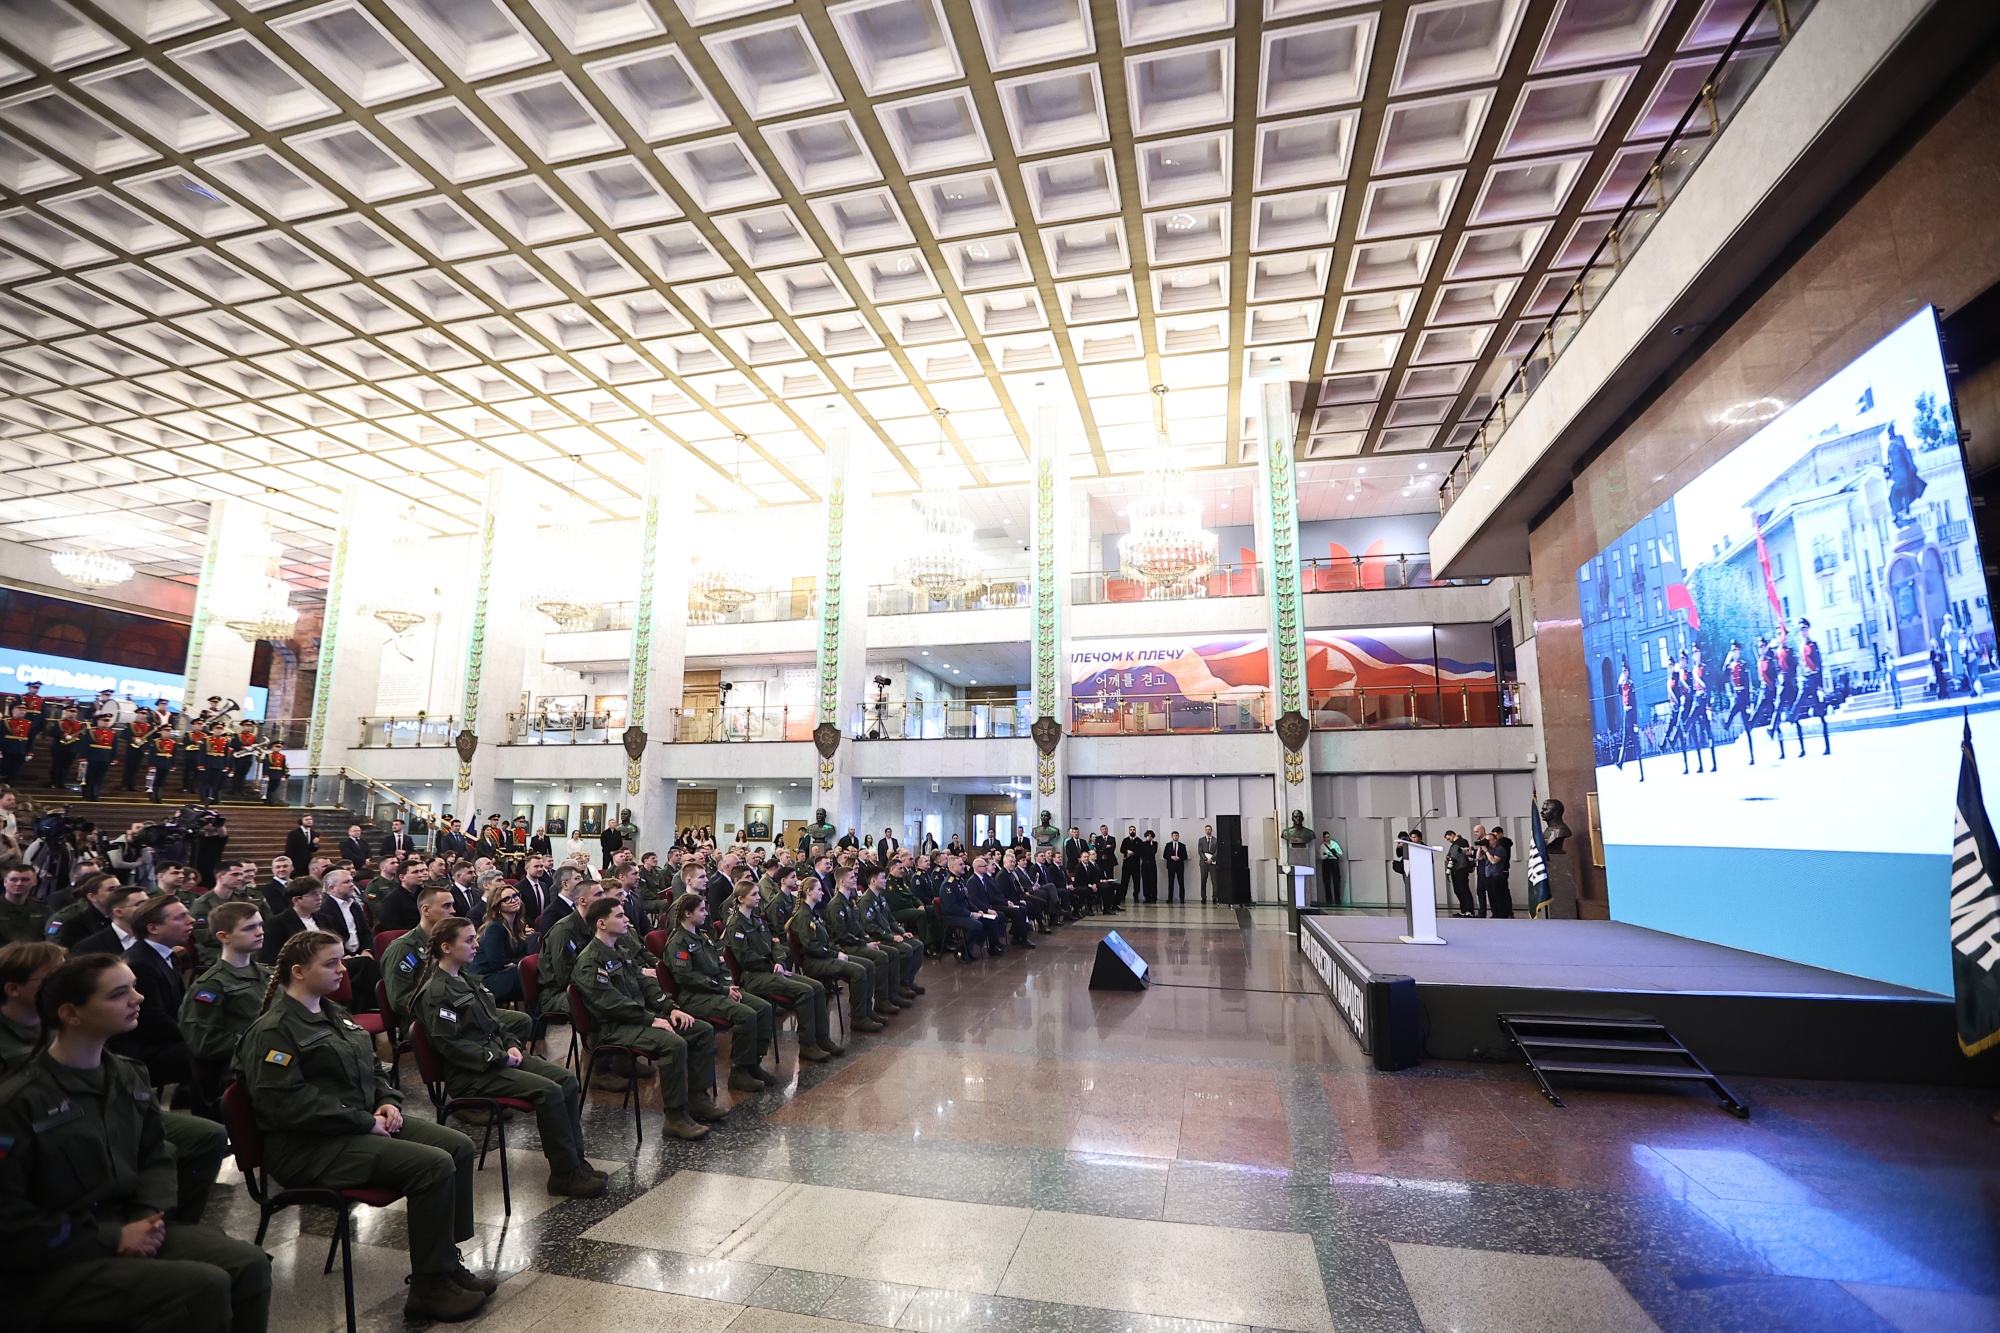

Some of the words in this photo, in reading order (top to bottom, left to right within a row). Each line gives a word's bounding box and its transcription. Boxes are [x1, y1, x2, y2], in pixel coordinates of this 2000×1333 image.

[1125, 651, 1135, 661] К
[1138, 649, 1184, 661] ПЛЕЧУ
[1096, 673, 1135, 688] 어깨를
